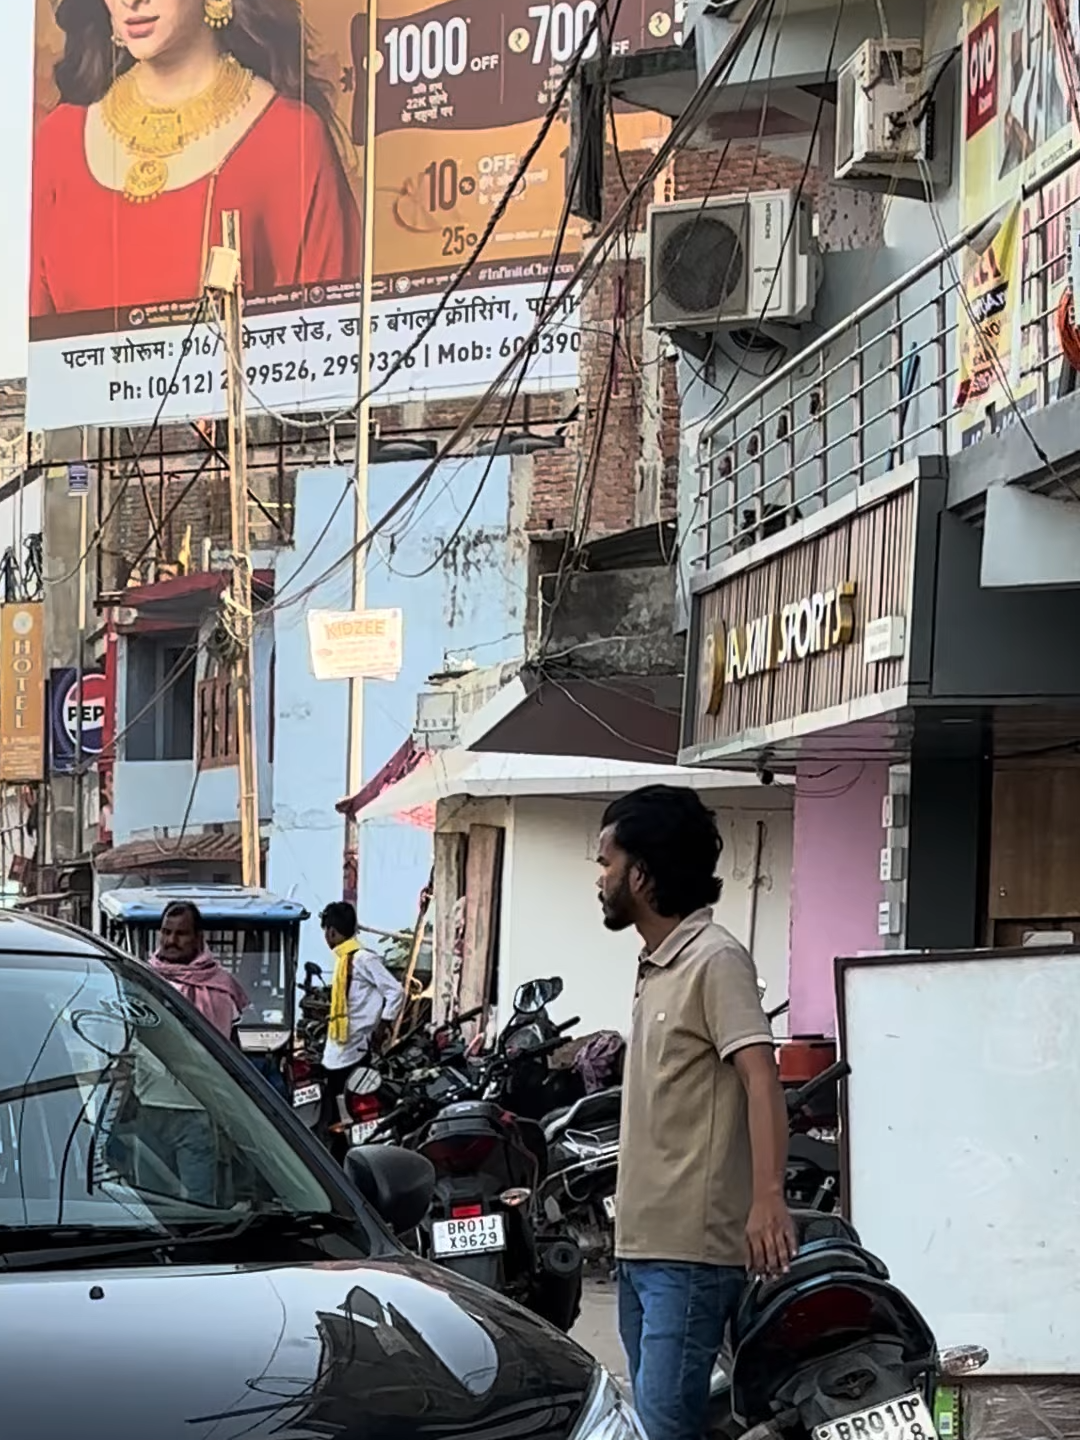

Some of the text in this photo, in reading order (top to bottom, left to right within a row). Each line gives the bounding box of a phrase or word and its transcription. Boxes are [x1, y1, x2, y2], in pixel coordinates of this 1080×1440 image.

[384, 17, 499, 85] 1000 OFF
[528, 1, 598, 64] 700
[606, 40, 629, 56] FF
[970, 26, 995, 96] OYO
[62, 346, 104, 369] पटना
[182, 334, 227, 357] 916/
[292, 316, 332, 342] रोड,
[109, 381, 142, 401] Ph:
[148, 370, 213, 399] (0612)
[220, 358, 317, 391] 299526,
[438, 341, 491, 364] Mob:
[324, 619, 385, 640] KIDZEE
[778, 581, 856, 663] SPORTS
[13, 639, 32, 729] HOTEL
[447, 1217, 497, 1235] BR01J
[449, 1231, 498, 1249] X9629
